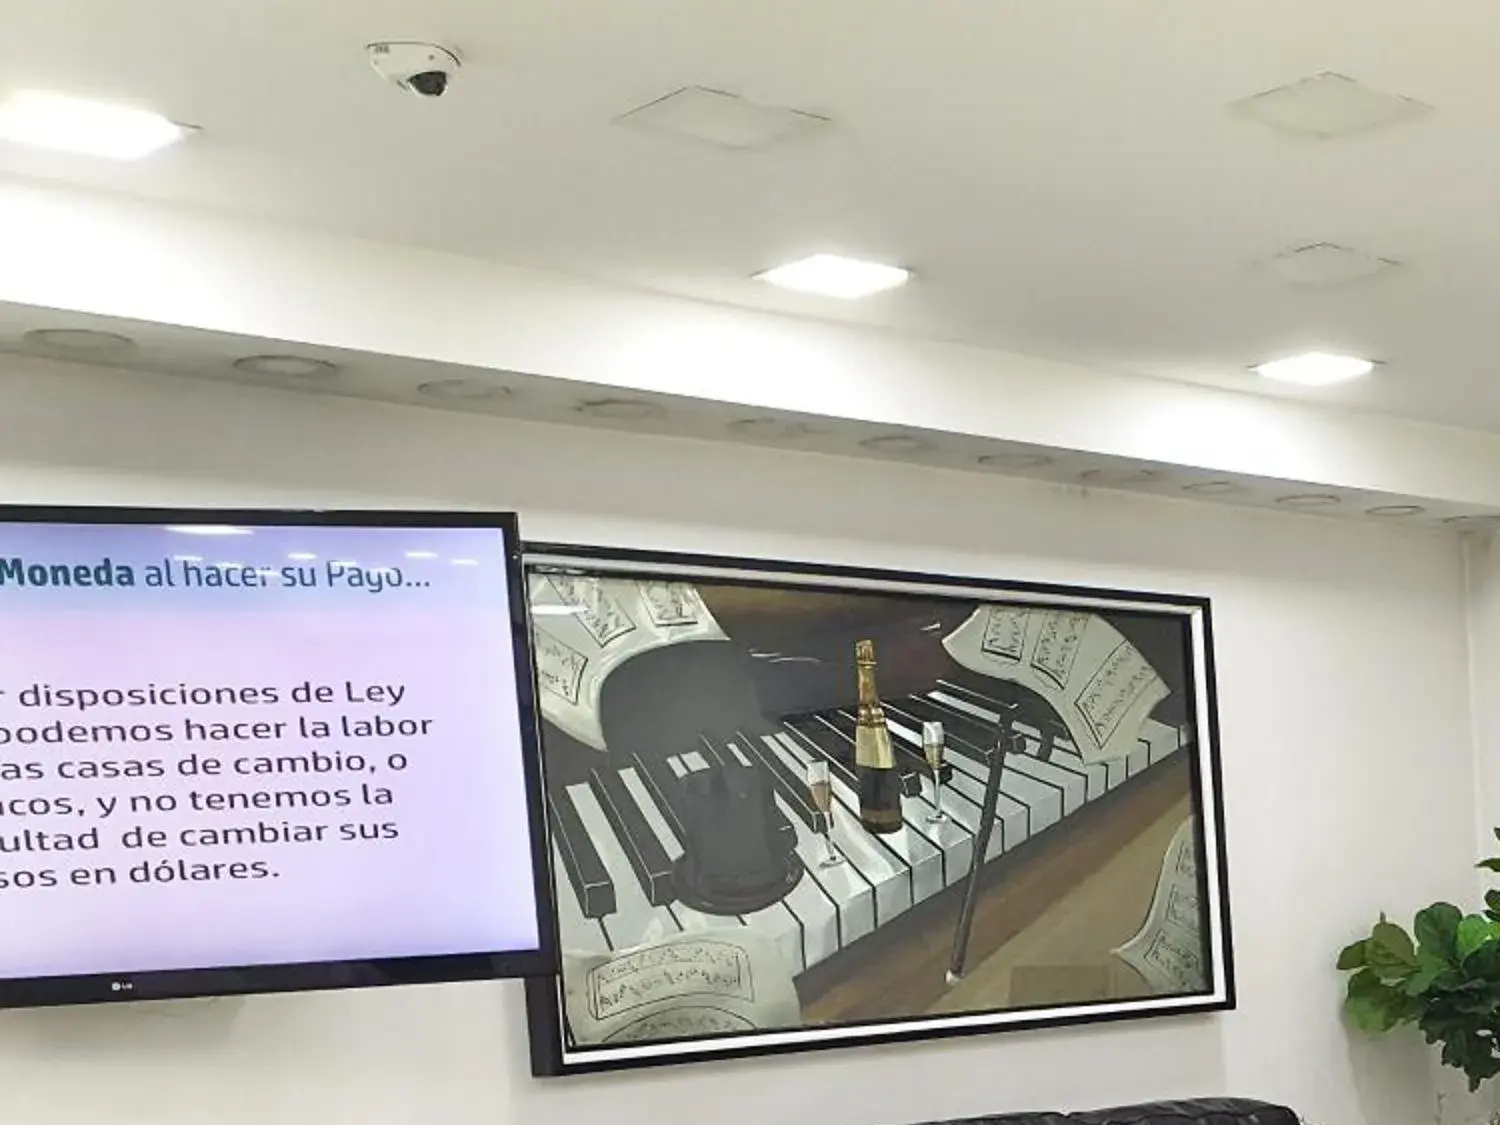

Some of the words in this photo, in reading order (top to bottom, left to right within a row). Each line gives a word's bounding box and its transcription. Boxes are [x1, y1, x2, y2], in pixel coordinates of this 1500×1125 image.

[0, 557, 135, 587] Moneda
[145, 557, 175, 587] al
[183, 559, 272, 587] hacer
[281, 565, 317, 587] su
[18, 683, 280, 711] disposiciones
[291, 681, 334, 704] de
[345, 681, 406, 707] Ley
[185, 716, 288, 741] hacer
[299, 716, 331, 739] la
[341, 715, 434, 738] labor
[57, 758, 166, 780] casas
[177, 753, 222, 776] de
[233, 750, 377, 776] cambio,
[387, 752, 408, 771] o
[0, 796, 85, 817] cos,
[97, 796, 118, 819] y
[130, 793, 178, 813] no
[189, 789, 352, 811] tenemos
[362, 783, 394, 805] la
[121, 826, 168, 850] de
[179, 821, 329, 848] cambiar
[339, 822, 400, 841] sus
[70, 867, 117, 886] en
[129, 858, 281, 884] dólares.
